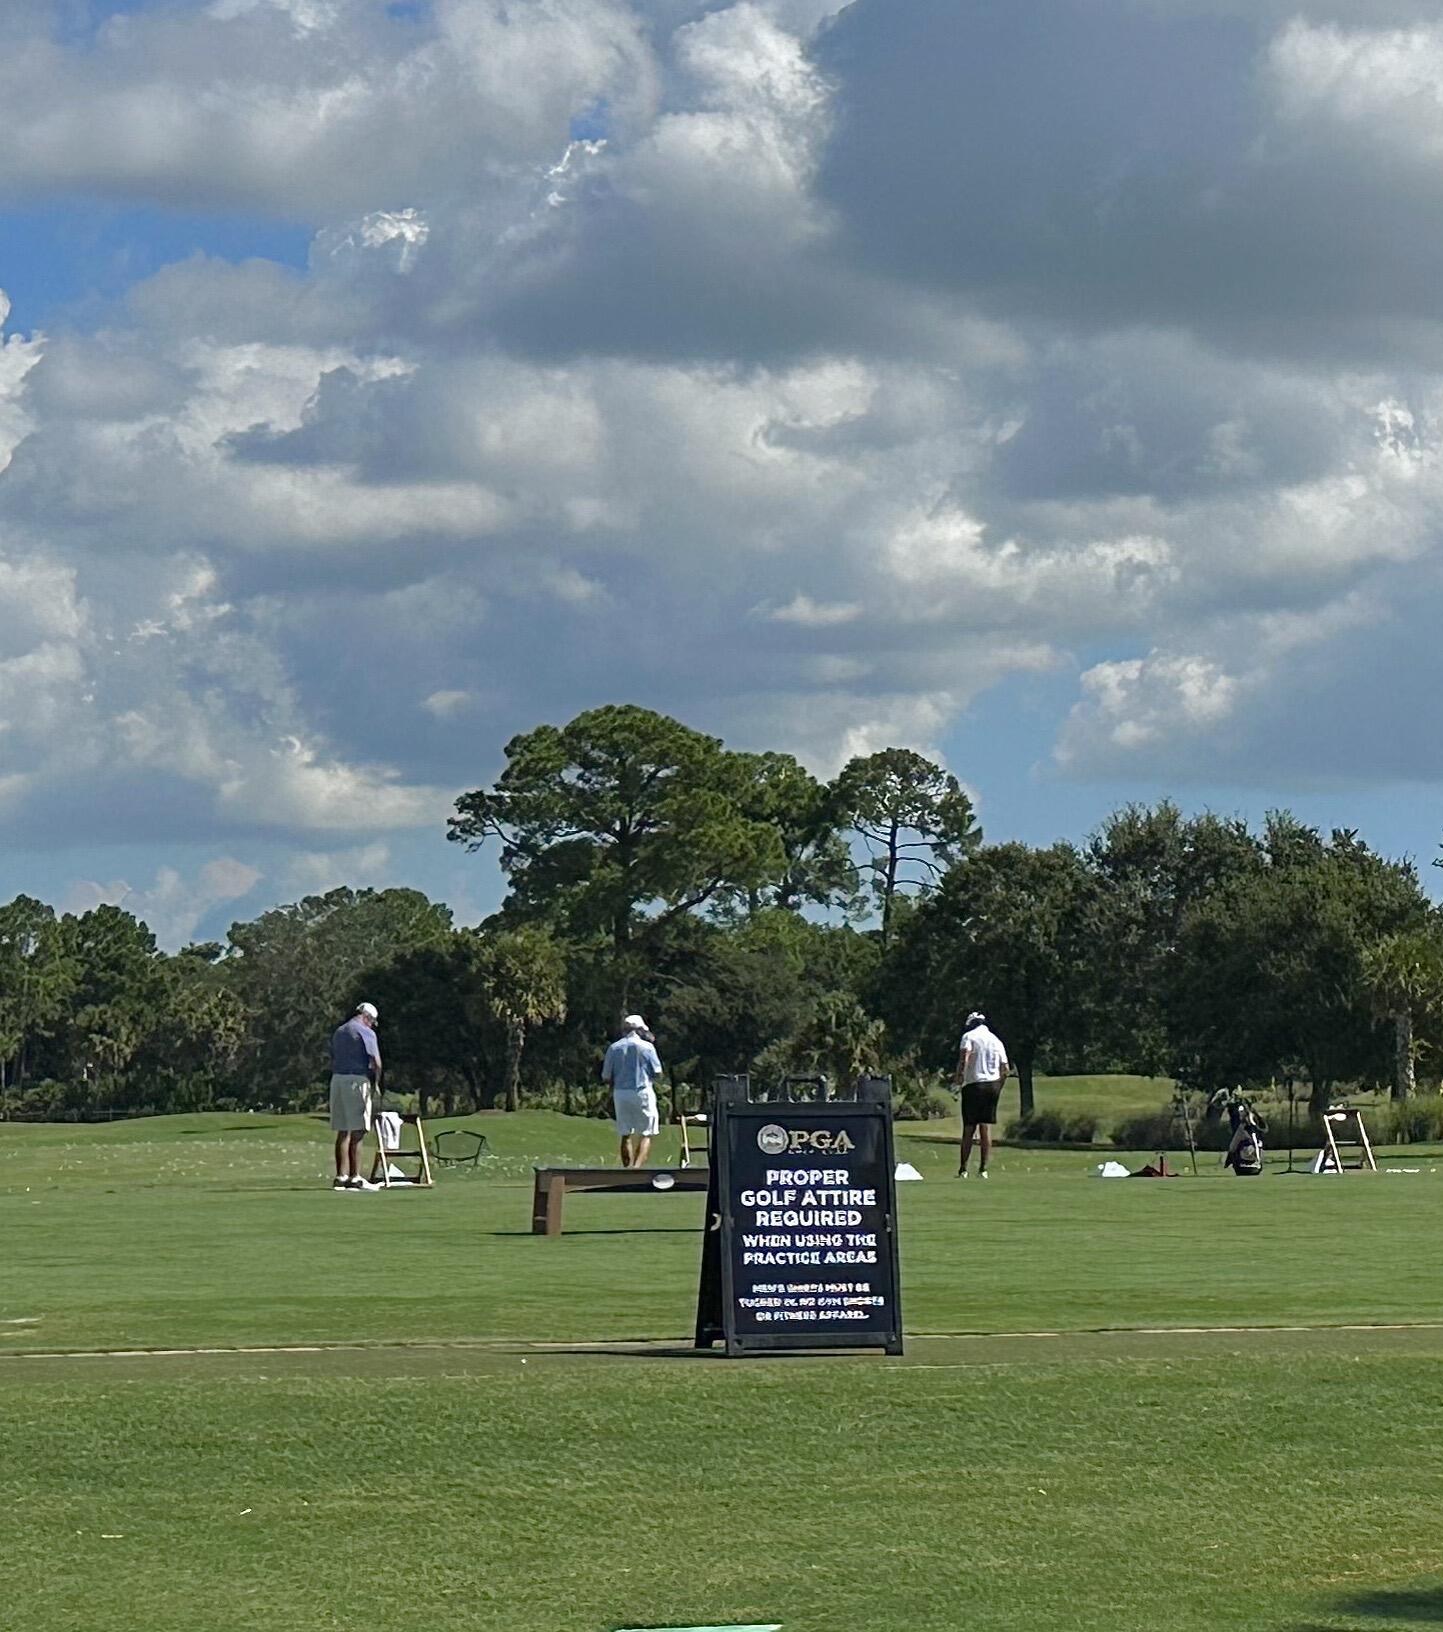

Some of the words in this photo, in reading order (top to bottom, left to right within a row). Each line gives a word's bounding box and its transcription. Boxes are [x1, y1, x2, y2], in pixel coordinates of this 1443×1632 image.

[789, 1130, 855, 1149] PGA
[766, 1170, 849, 1185] PROPER
[741, 1190, 796, 1206] GOLF
[801, 1189, 876, 1206] ATTIRE
[756, 1210, 862, 1226] REQUIRED
[742, 1234, 791, 1247] WHEN
[795, 1234, 843, 1247] USING
[846, 1234, 877, 1246] THE
[744, 1252, 820, 1264] PRACTICE
[824, 1251, 877, 1264] AREAS
